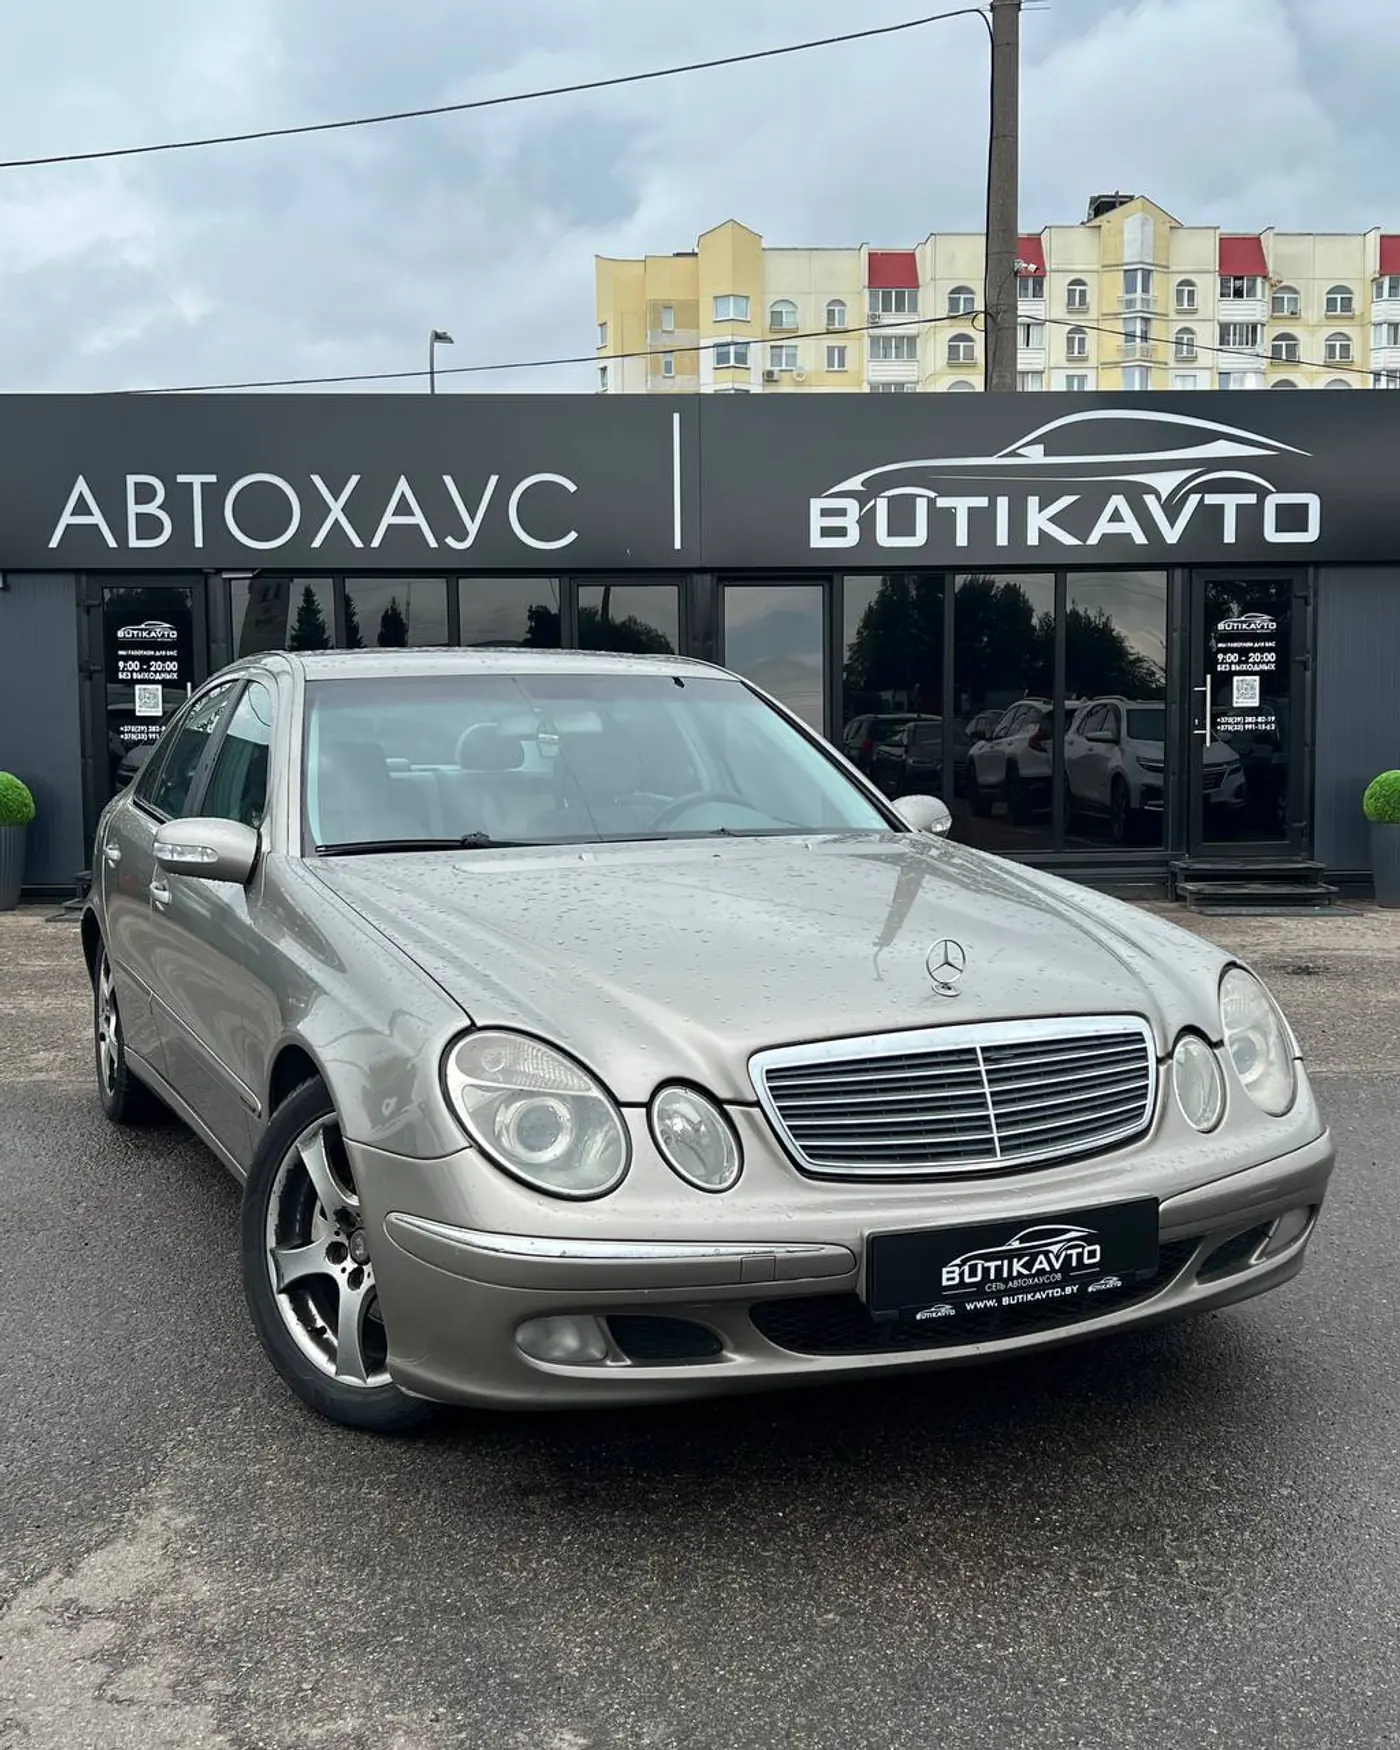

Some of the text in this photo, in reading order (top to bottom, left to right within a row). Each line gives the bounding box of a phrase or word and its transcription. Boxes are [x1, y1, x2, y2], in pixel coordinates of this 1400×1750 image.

[48, 472, 579, 550] АВТОХАУС
[809, 491, 1321, 549] BUTIKAVTO
[1217, 622, 1277, 630] BUTIKAVTO
[117, 630, 178, 638] BUTIKAVTO
[1217, 653, 1239, 663] 9:00
[1248, 652, 1276, 662] 20:00
[118, 661, 140, 671] 9:00
[149, 661, 178, 671] 20:00
[1217, 663, 1276, 672] БЕЗ ВЫХОДНЫХ
[132, 672, 178, 680] ВЫХОДНЫХ
[941, 1244, 1101, 1287] BUTIKAVTO
[985, 1272, 1063, 1292] СЕТЬ АВТОХАУСОВ
[965, 1285, 1079, 1311] WWW. BUTIKAVTO.BY
